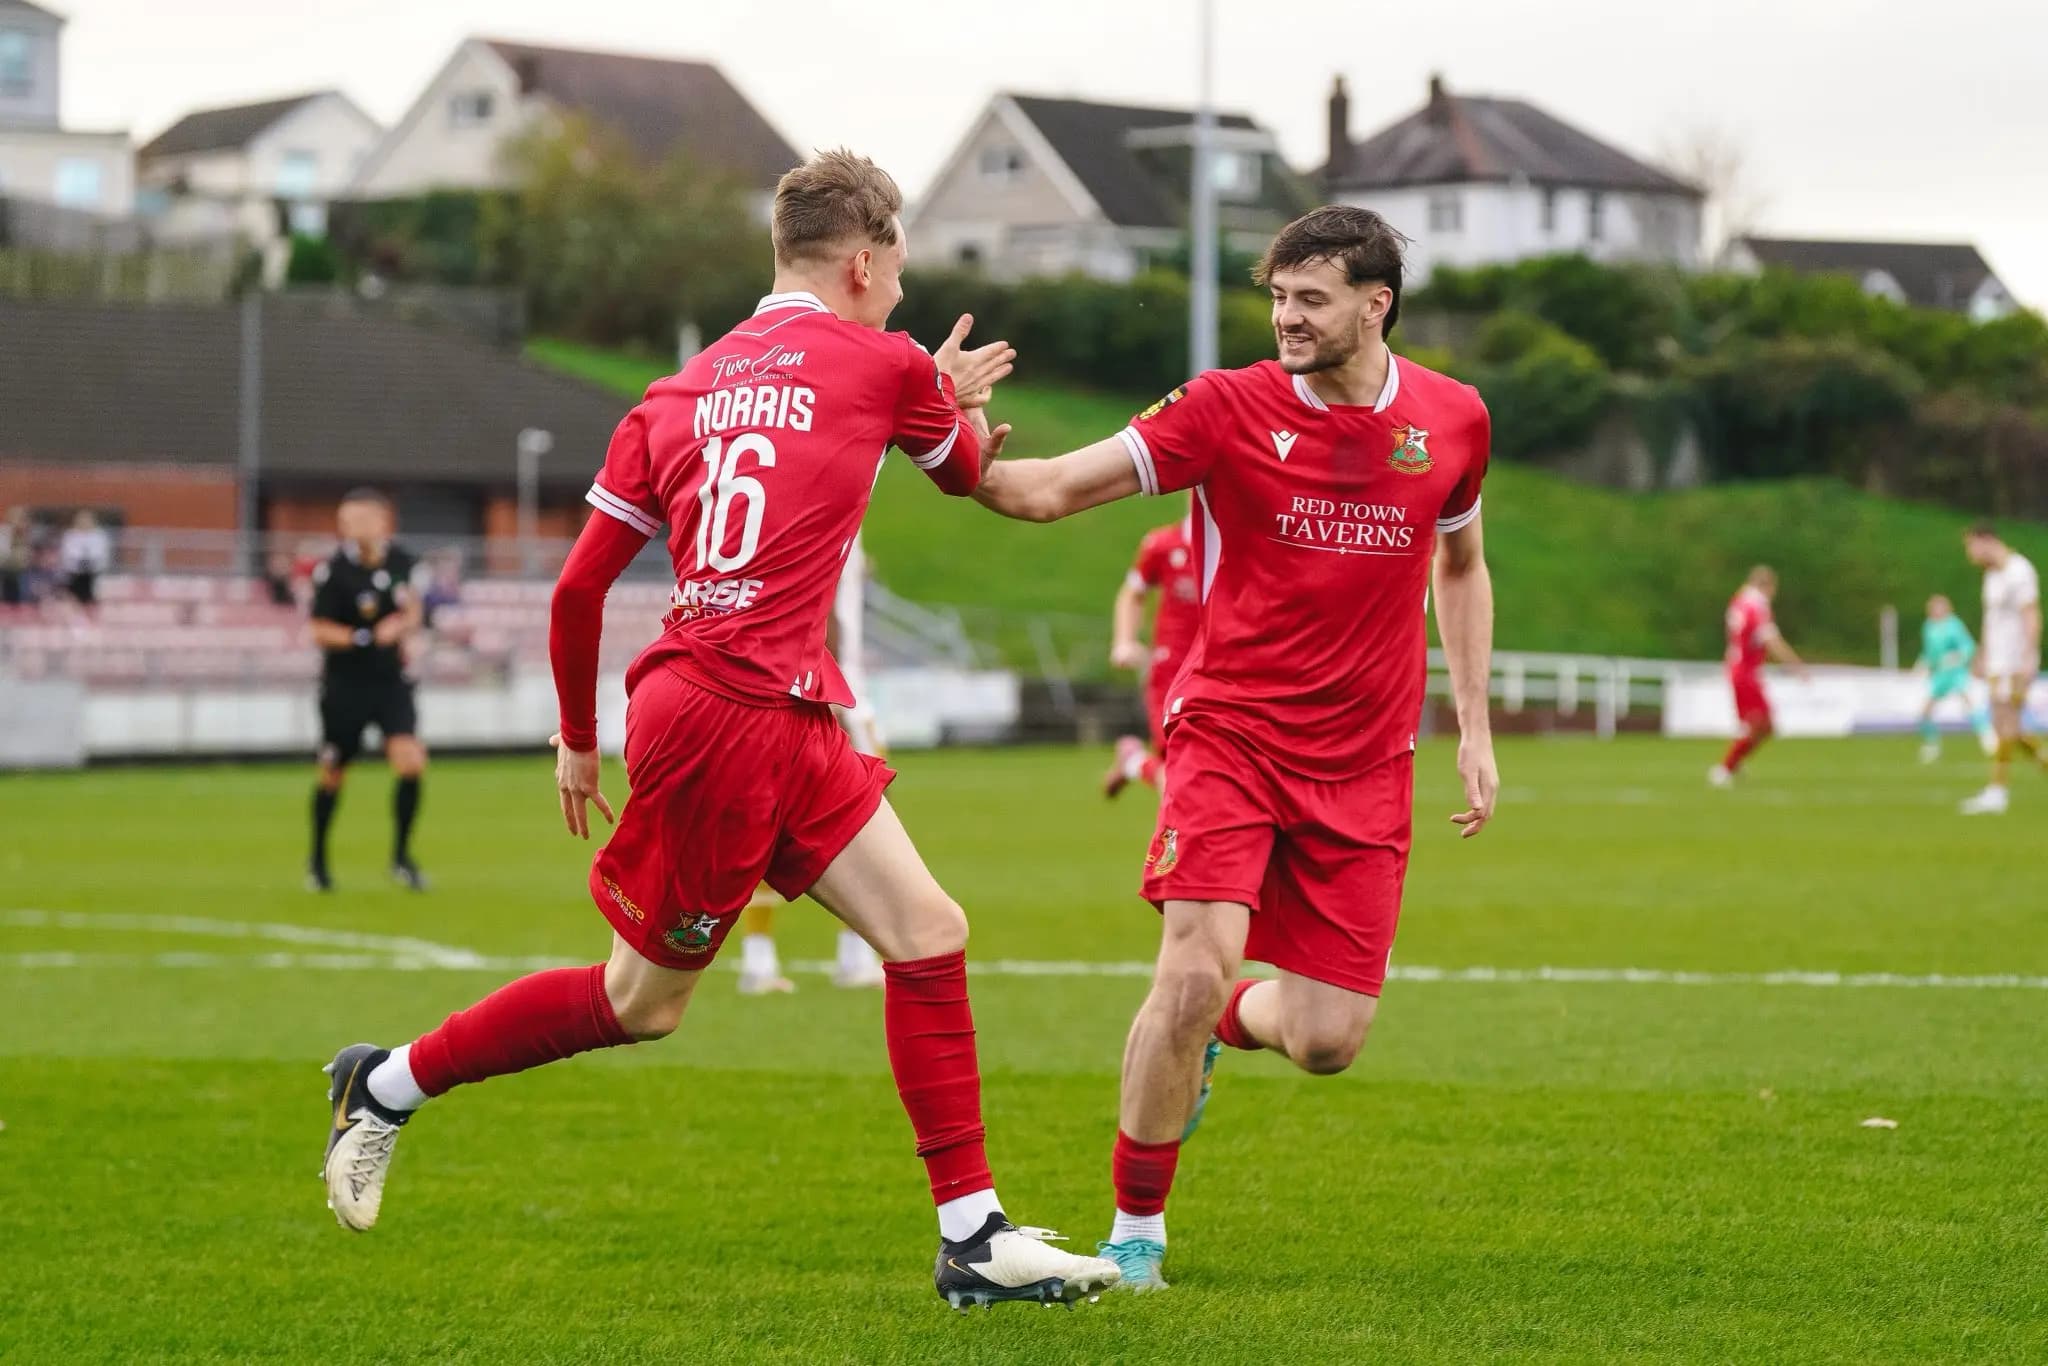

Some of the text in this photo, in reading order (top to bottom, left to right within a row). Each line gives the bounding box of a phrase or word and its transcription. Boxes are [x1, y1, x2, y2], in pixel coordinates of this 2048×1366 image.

[711, 344, 806, 388] Two Can
[693, 386, 816, 439] NORRIS
[696, 433, 777, 573] 16
[1291, 496, 1408, 523] RED TOWN
[1276, 513, 1415, 548] TAVERNS
